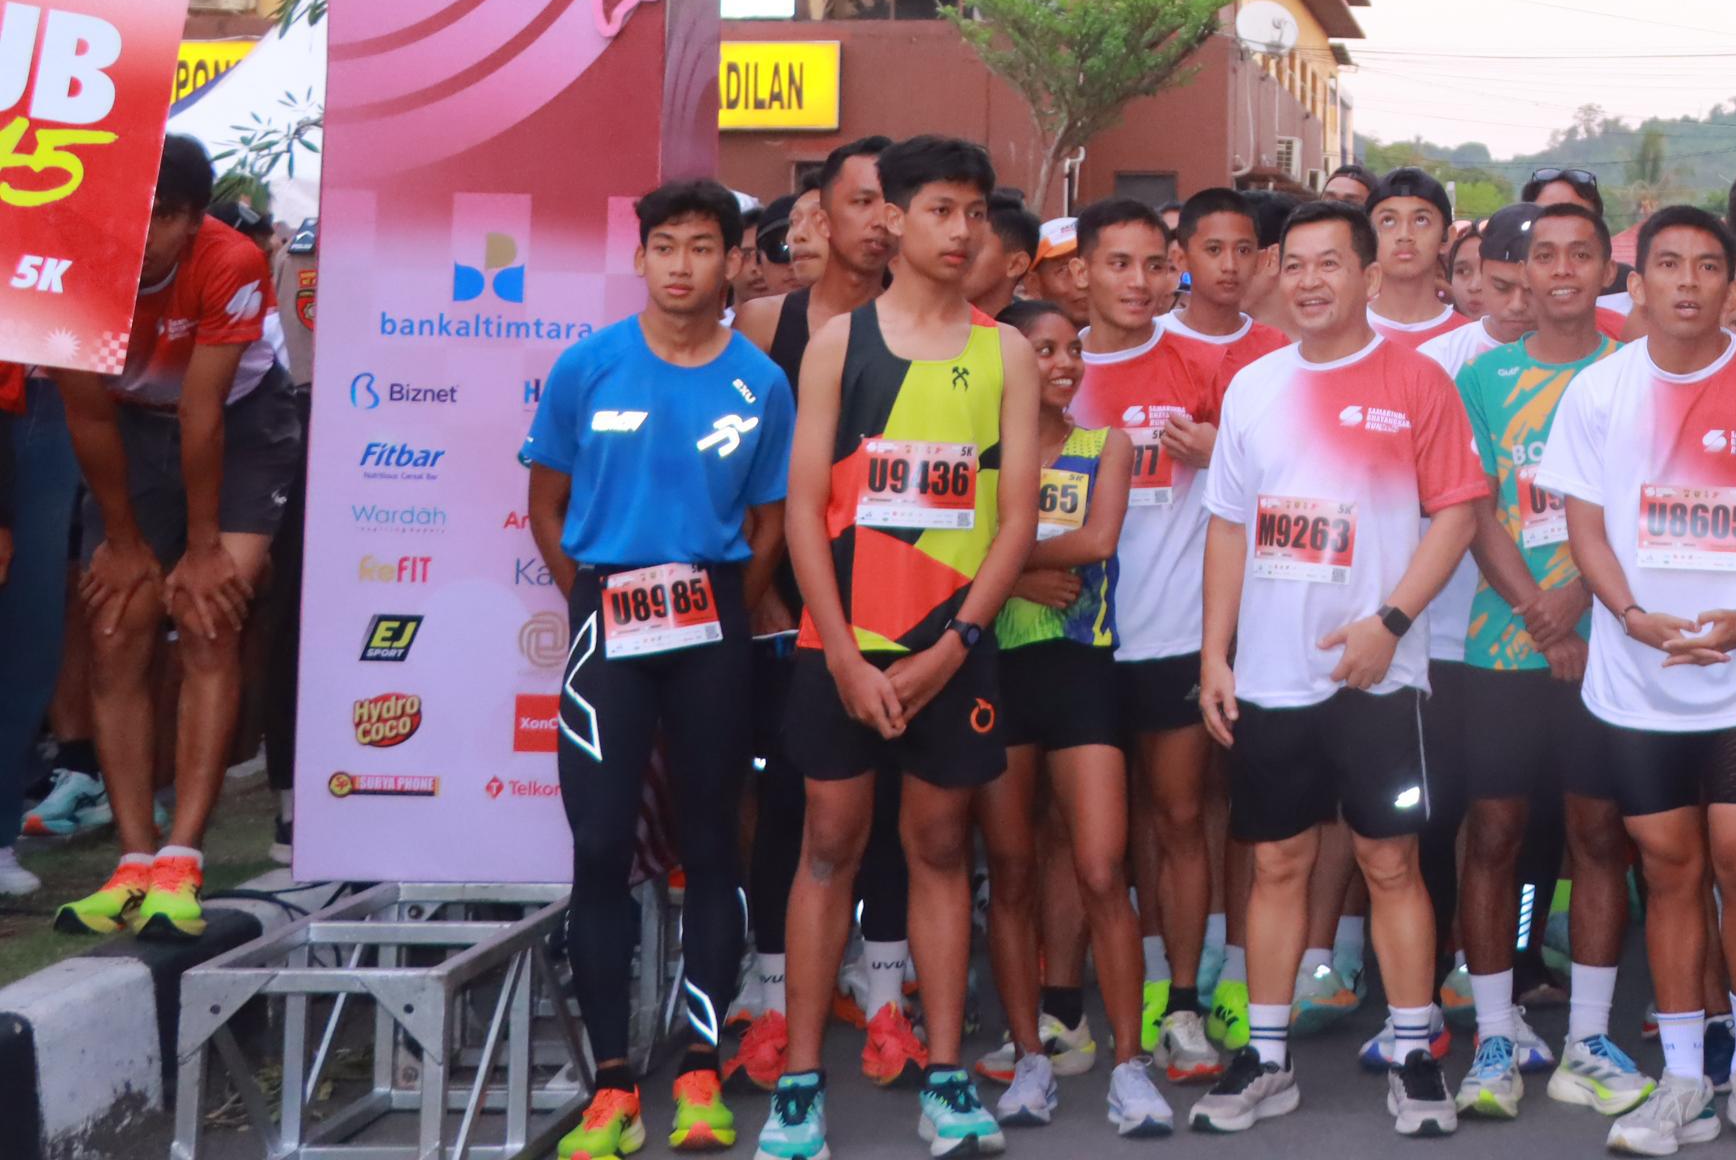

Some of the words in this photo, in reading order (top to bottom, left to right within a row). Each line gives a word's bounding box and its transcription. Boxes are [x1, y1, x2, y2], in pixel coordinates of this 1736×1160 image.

[720, 62, 804, 110] DILAN
[10, 255, 72, 293] 5K
[380, 312, 593, 340] bankaltimtara
[389, 383, 457, 403] Biznet
[360, 442, 445, 468] Fitbar
[961, 446, 974, 456] 5K
[1259, 513, 1350, 553] M9263
[612, 577, 710, 626] U8985
[369, 620, 419, 648] EJ
[366, 648, 405, 657] SPORT
[354, 694, 421, 725] Hydro
[519, 717, 560, 730] XonC
[359, 775, 396, 790] SURYA
[397, 776, 434, 790] PHONE
[508, 780, 561, 796] Telko
